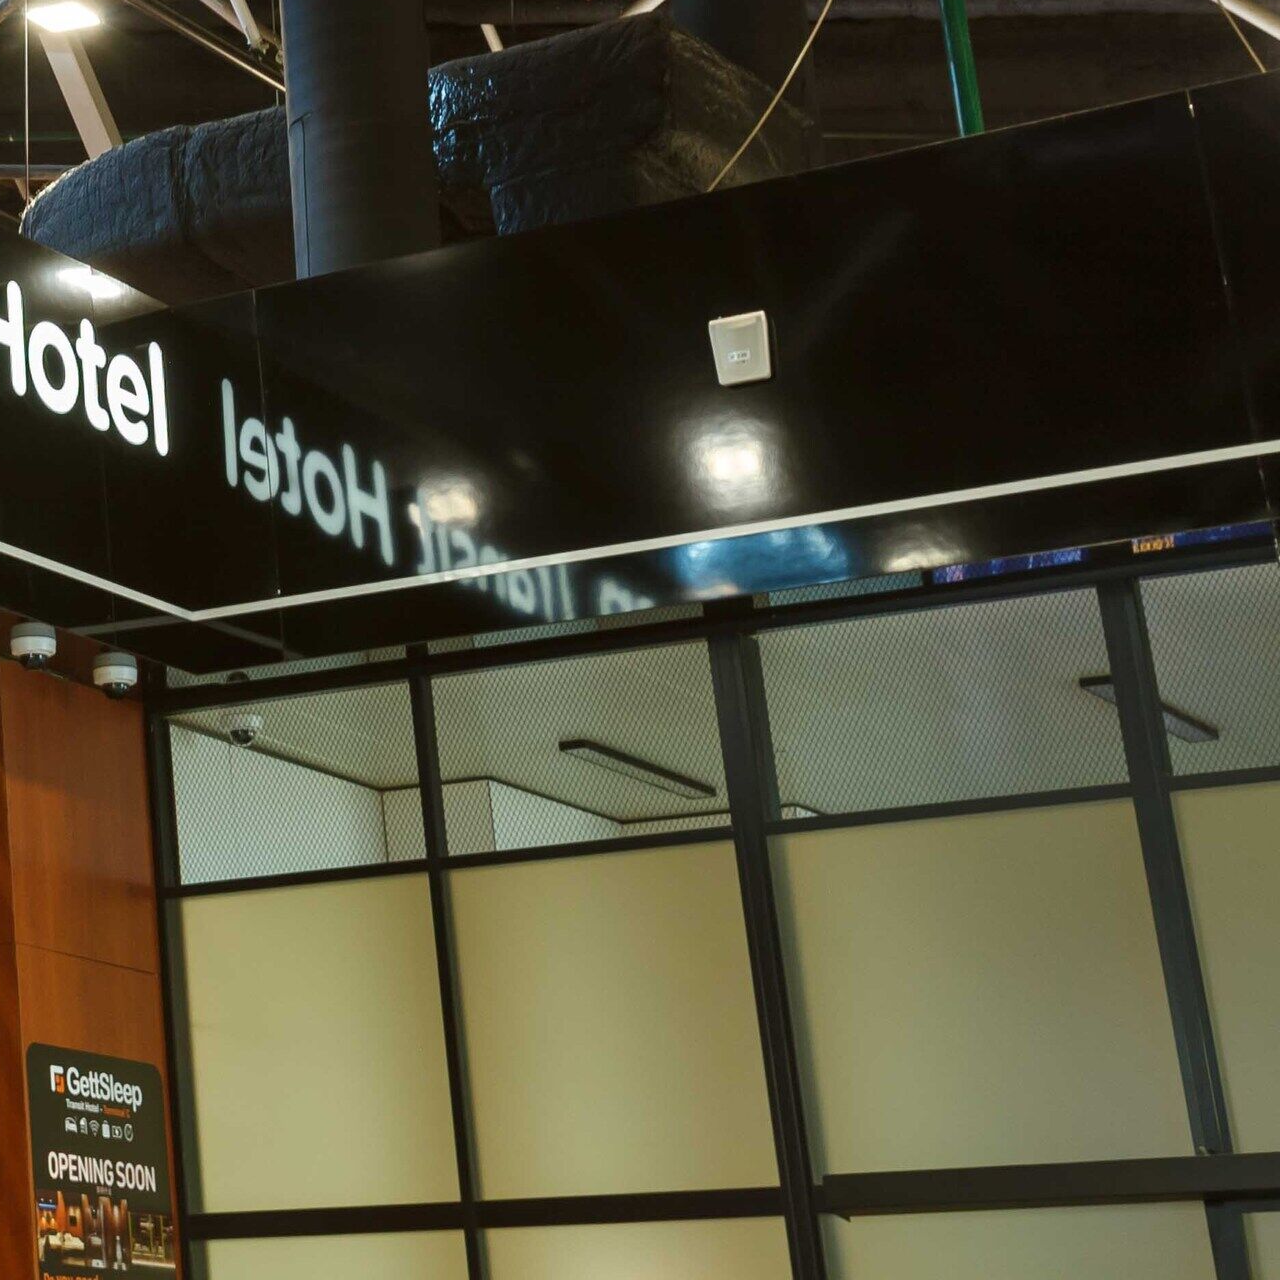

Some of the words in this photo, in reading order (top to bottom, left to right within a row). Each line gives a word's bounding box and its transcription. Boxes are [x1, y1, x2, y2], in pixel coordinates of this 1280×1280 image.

[66, 1066, 142, 1112] GettSleep
[47, 1150, 114, 1187] OPENING
[116, 1160, 156, 1192] SOON
